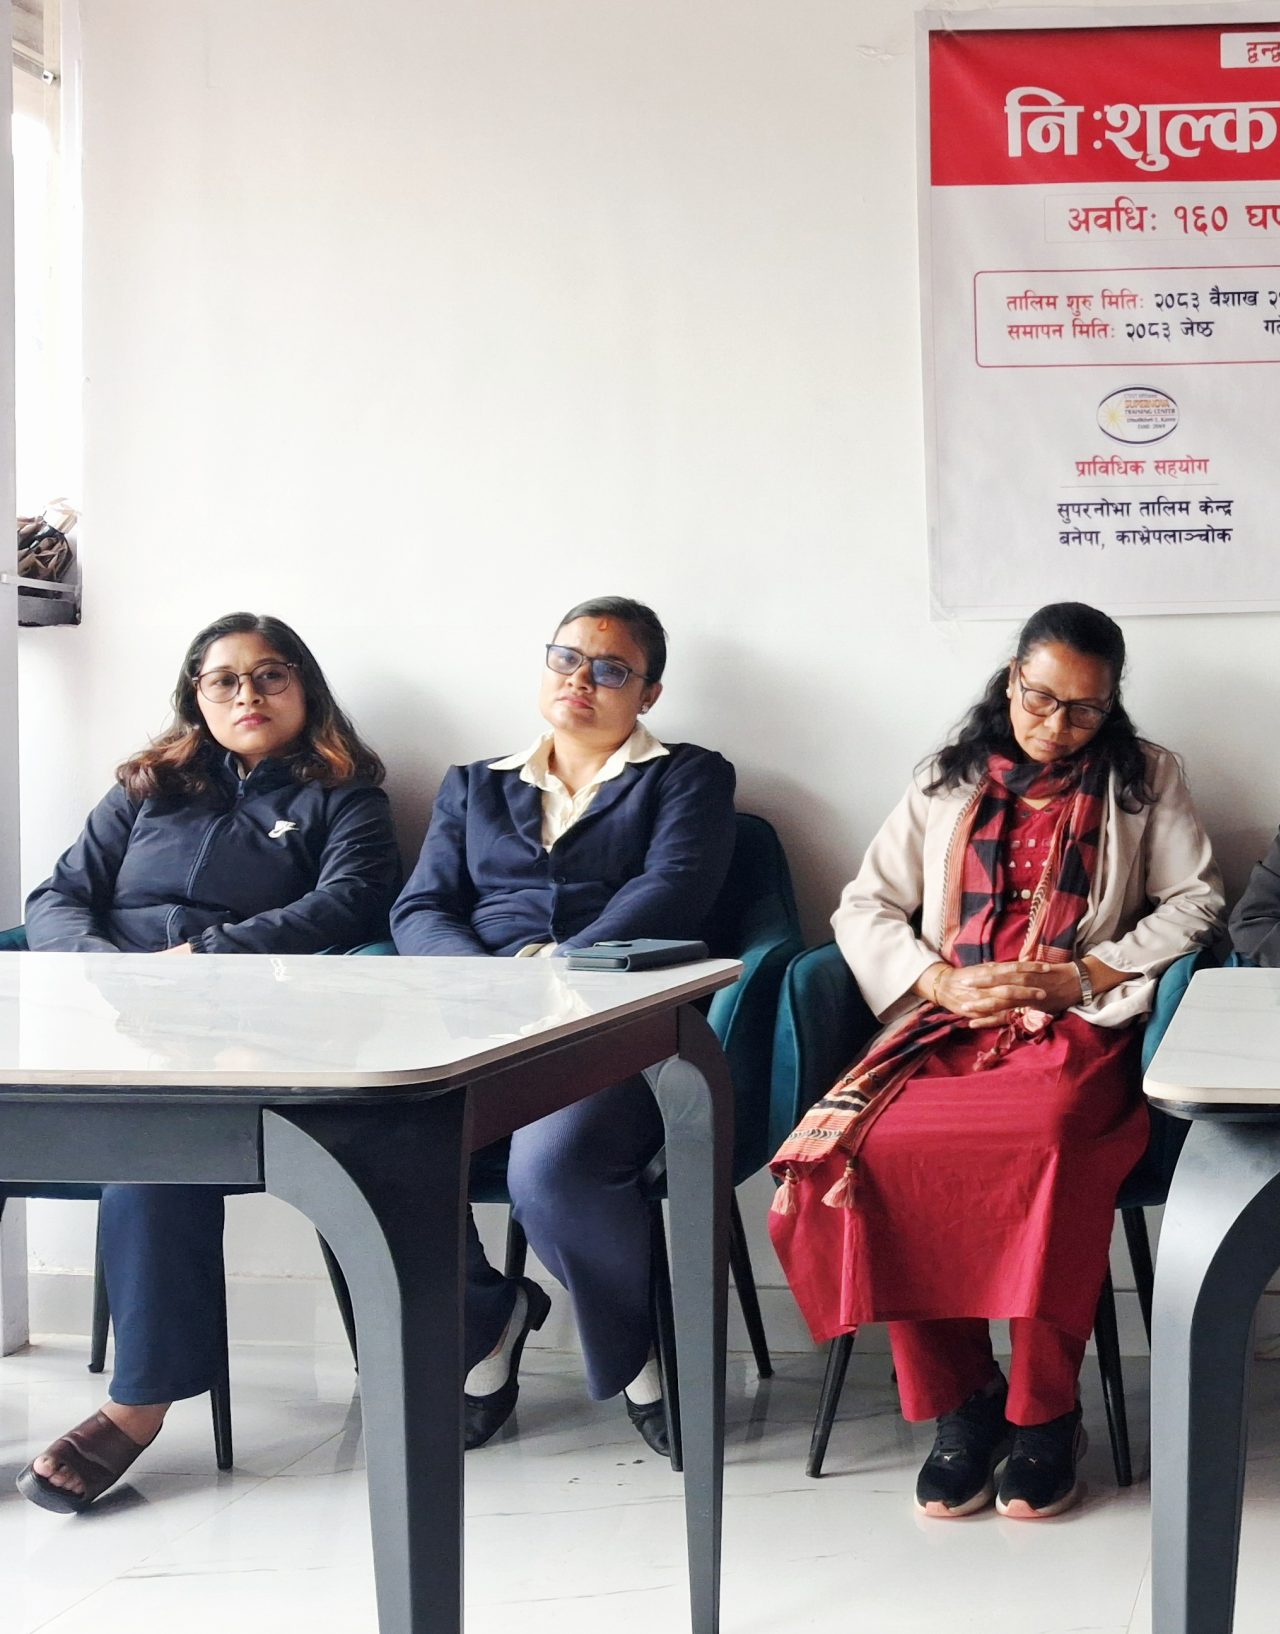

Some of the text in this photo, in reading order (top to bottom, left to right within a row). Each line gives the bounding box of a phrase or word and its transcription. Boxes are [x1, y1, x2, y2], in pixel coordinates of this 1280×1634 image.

[1174, 206, 1228, 236] १६०
[1007, 290, 1059, 310] तालिम
[1155, 293, 1199, 310] २०८३
[1209, 286, 1259, 306] वैशाख
[1007, 324, 1064, 339] समापन
[1126, 323, 1170, 341] २०८३
[1180, 317, 1214, 337] जेष्ठ
[1075, 455, 1210, 478] प्राविधिक सहयोग
[1057, 496, 1233, 524] सुपरनोभा तालिम केन्द्र
[1059, 527, 1105, 549] बनेपा,
